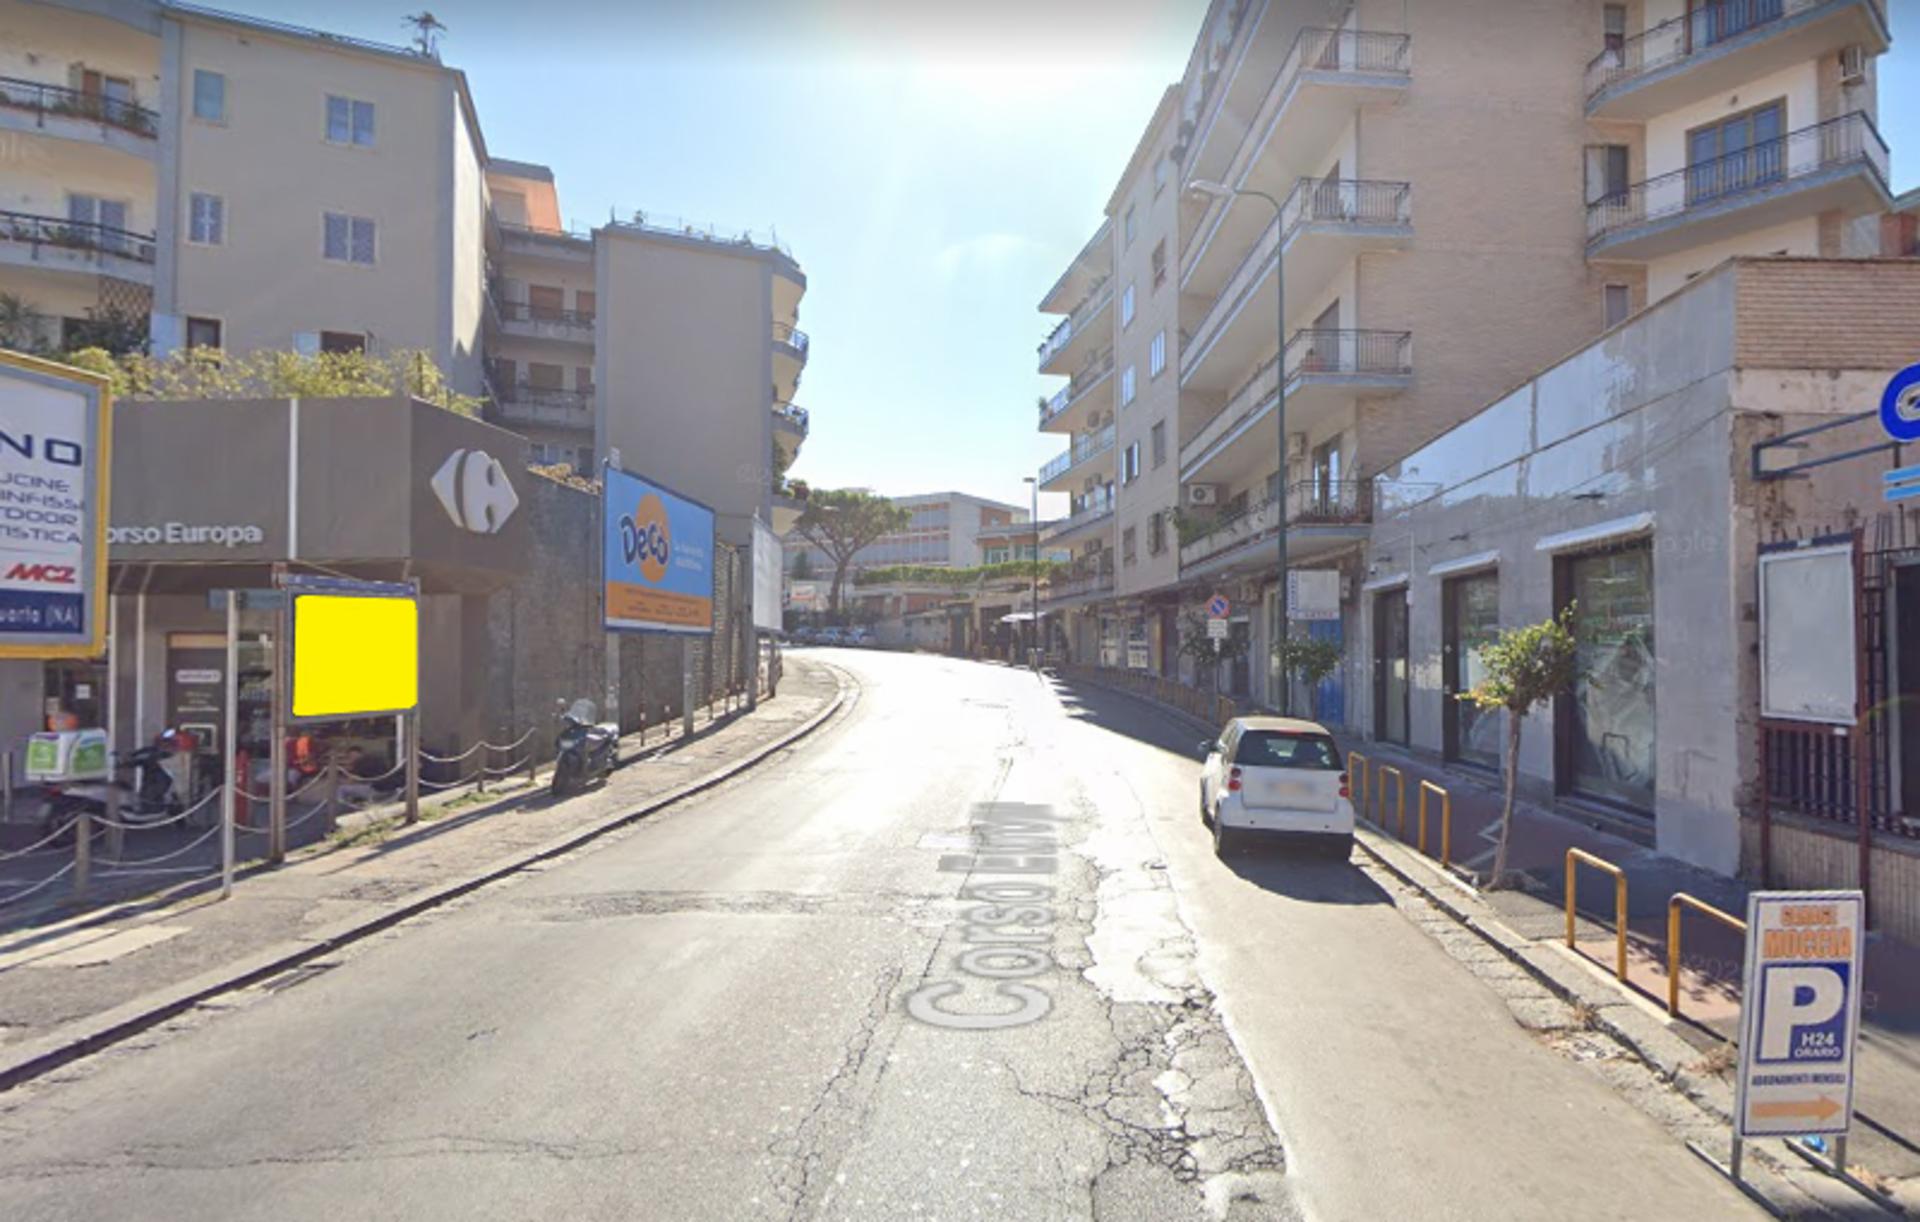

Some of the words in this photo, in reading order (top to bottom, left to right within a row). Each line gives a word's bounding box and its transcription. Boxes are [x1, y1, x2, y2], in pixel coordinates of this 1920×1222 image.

[165, 522, 264, 548] Europa
[5, 563, 75, 584] MCZ
[1763, 928, 1851, 958] MOCCIA
[1760, 966, 1845, 1060] P
[1801, 1032, 1835, 1047] H24
[1794, 1046, 1841, 1058] ORARIO
